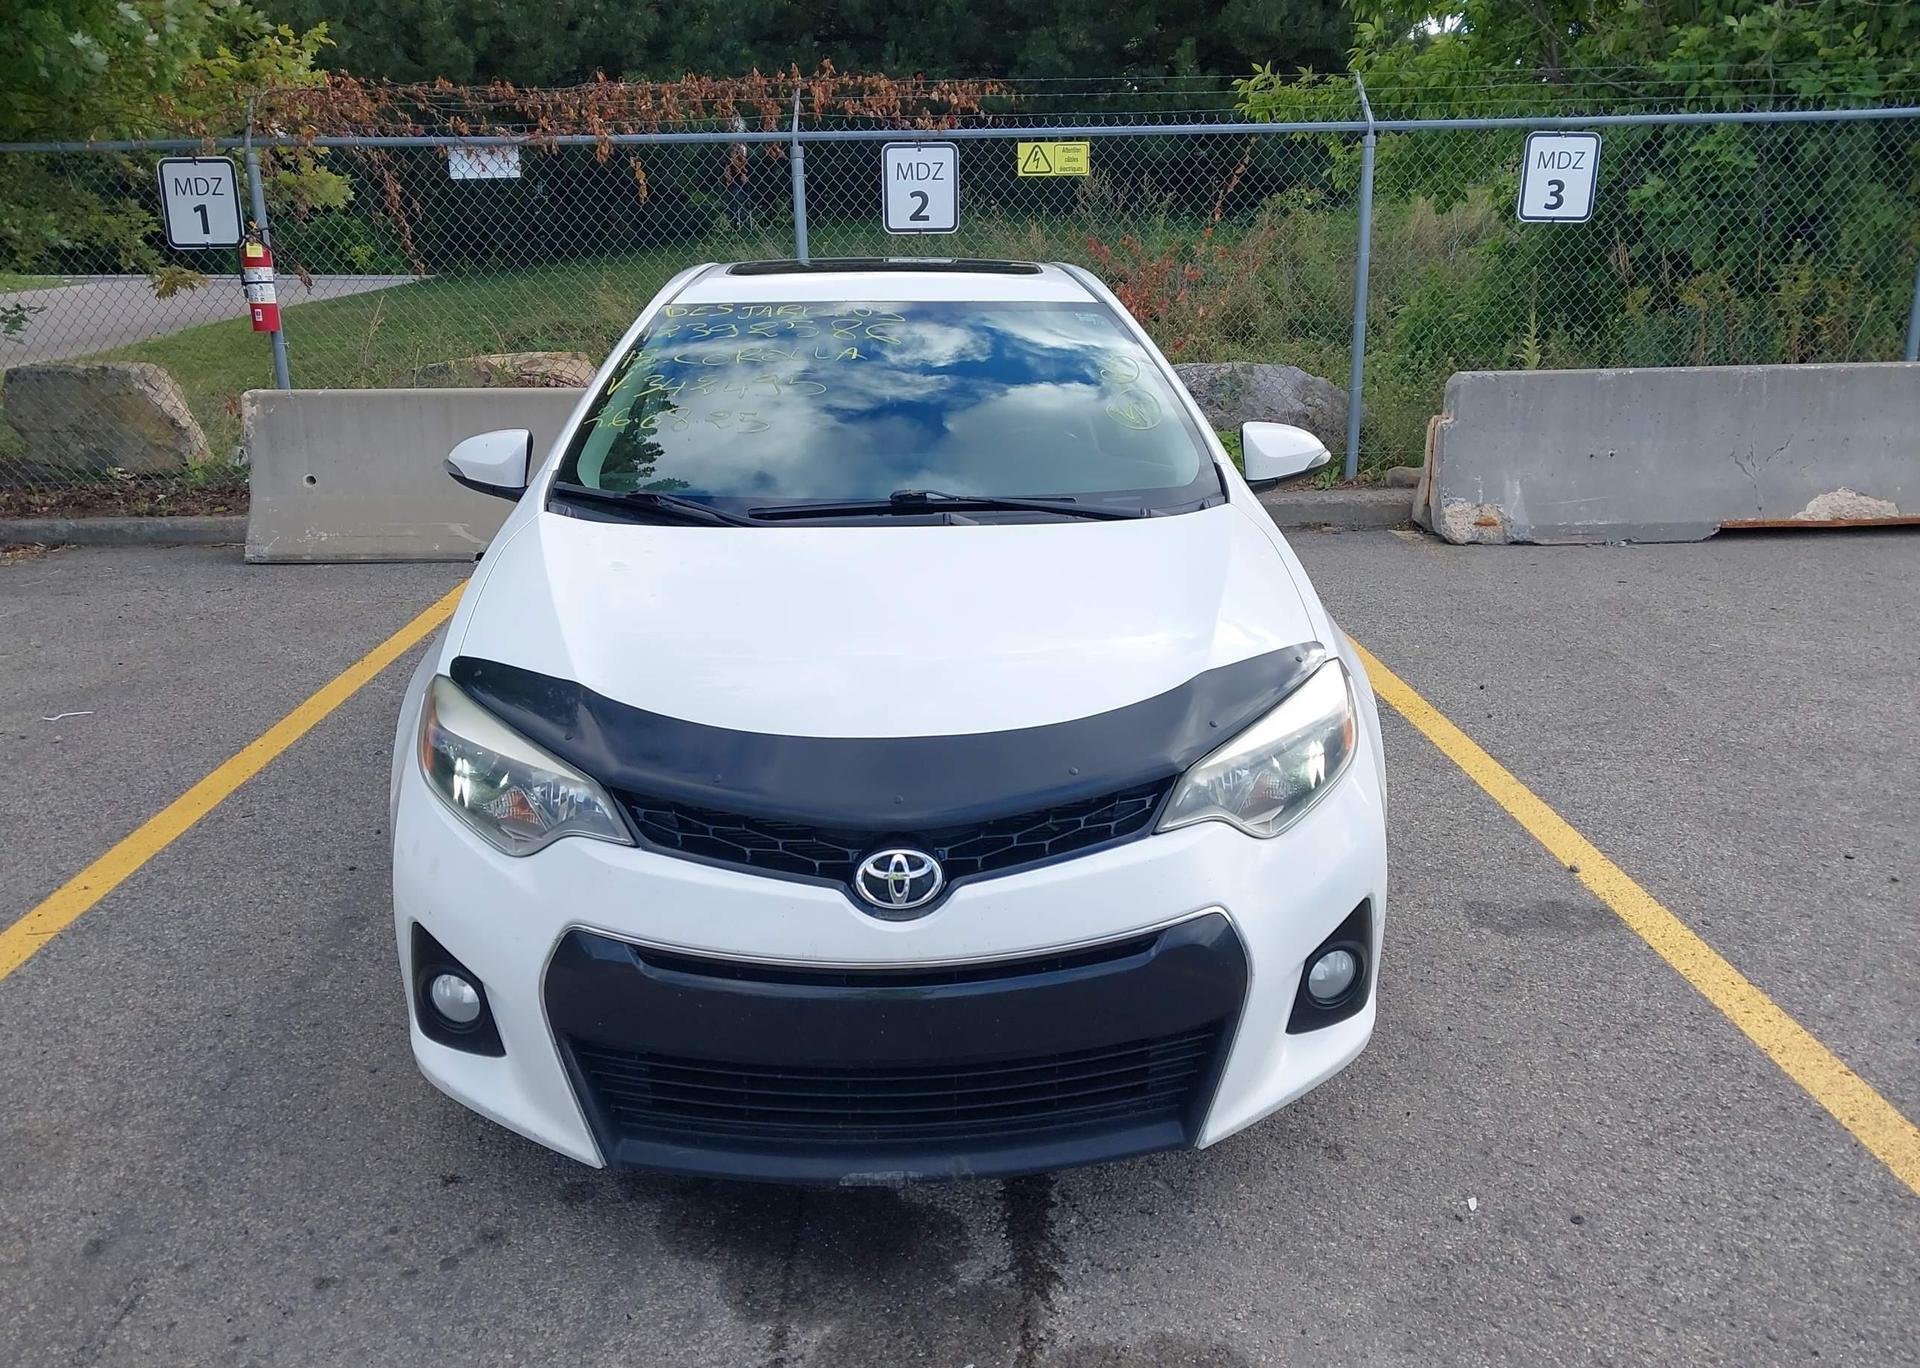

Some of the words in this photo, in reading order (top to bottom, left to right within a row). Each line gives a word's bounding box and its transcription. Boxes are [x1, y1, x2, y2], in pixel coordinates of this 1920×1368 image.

[896, 162, 945, 181] MDZ
[1537, 151, 1586, 170] MDZ
[174, 177, 224, 196] MDZ
[1543, 179, 1566, 210] 3
[909, 190, 930, 221] 2
[193, 204, 210, 235] 1
